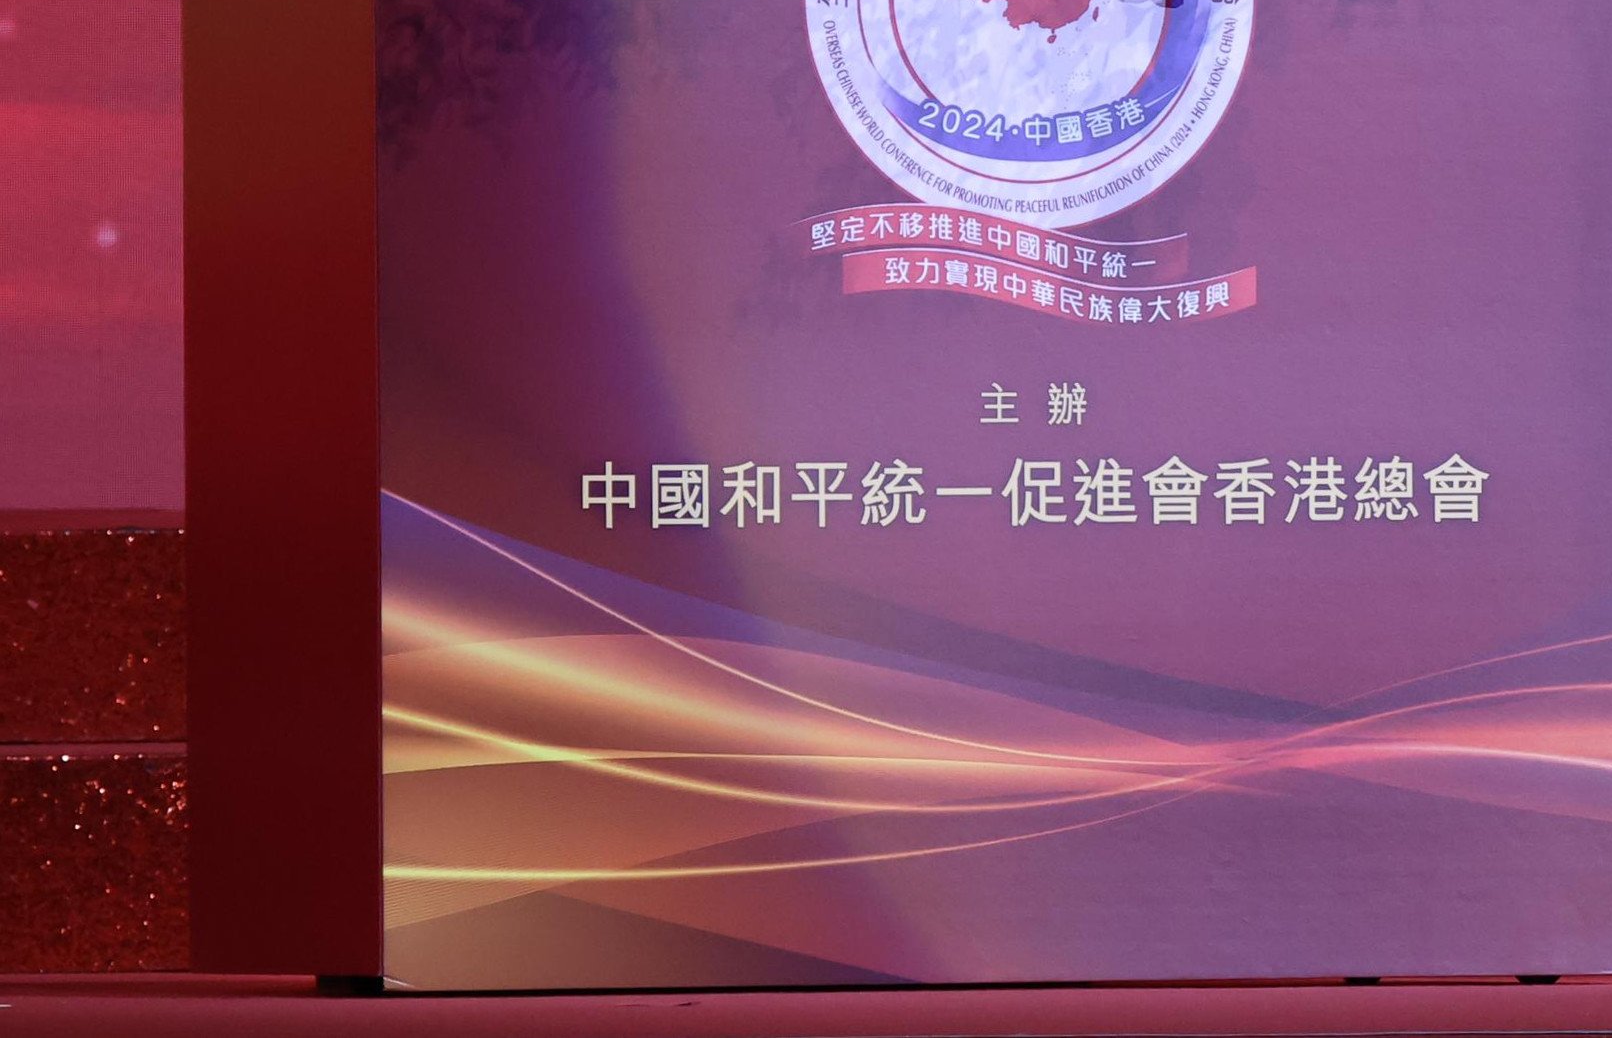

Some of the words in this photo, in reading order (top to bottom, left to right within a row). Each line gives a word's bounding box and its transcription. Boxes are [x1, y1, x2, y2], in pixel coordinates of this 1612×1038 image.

[823, 20, 845, 69] OVERSEAS
[836, 68, 862, 112] CHINESE
[857, 104, 885, 142] WORLD
[880, 138, 935, 186] CONFERENCE
[933, 176, 954, 196] FOR
[953, 186, 1014, 212] PROMOTING
[1014, 200, 1060, 213] PEACEFUL
[1062, 173, 1133, 209] REUNIFICATION
[1132, 164, 1147, 182] OF
[1144, 144, 1175, 172] CHINA
[1169, 123, 1193, 150] (2024
[1191, 88, 1216, 121] HONG
[1207, 57, 1231, 89] KONG,
[1219, 17, 1237, 54] CHINA)
[811, 212, 1156, 278] 堅定不移推進中國和平統一
[884, 257, 1229, 324] 致力實現中華民族偉大復興
[581, 453, 1490, 529] 中國和平統一促進會香港總會
